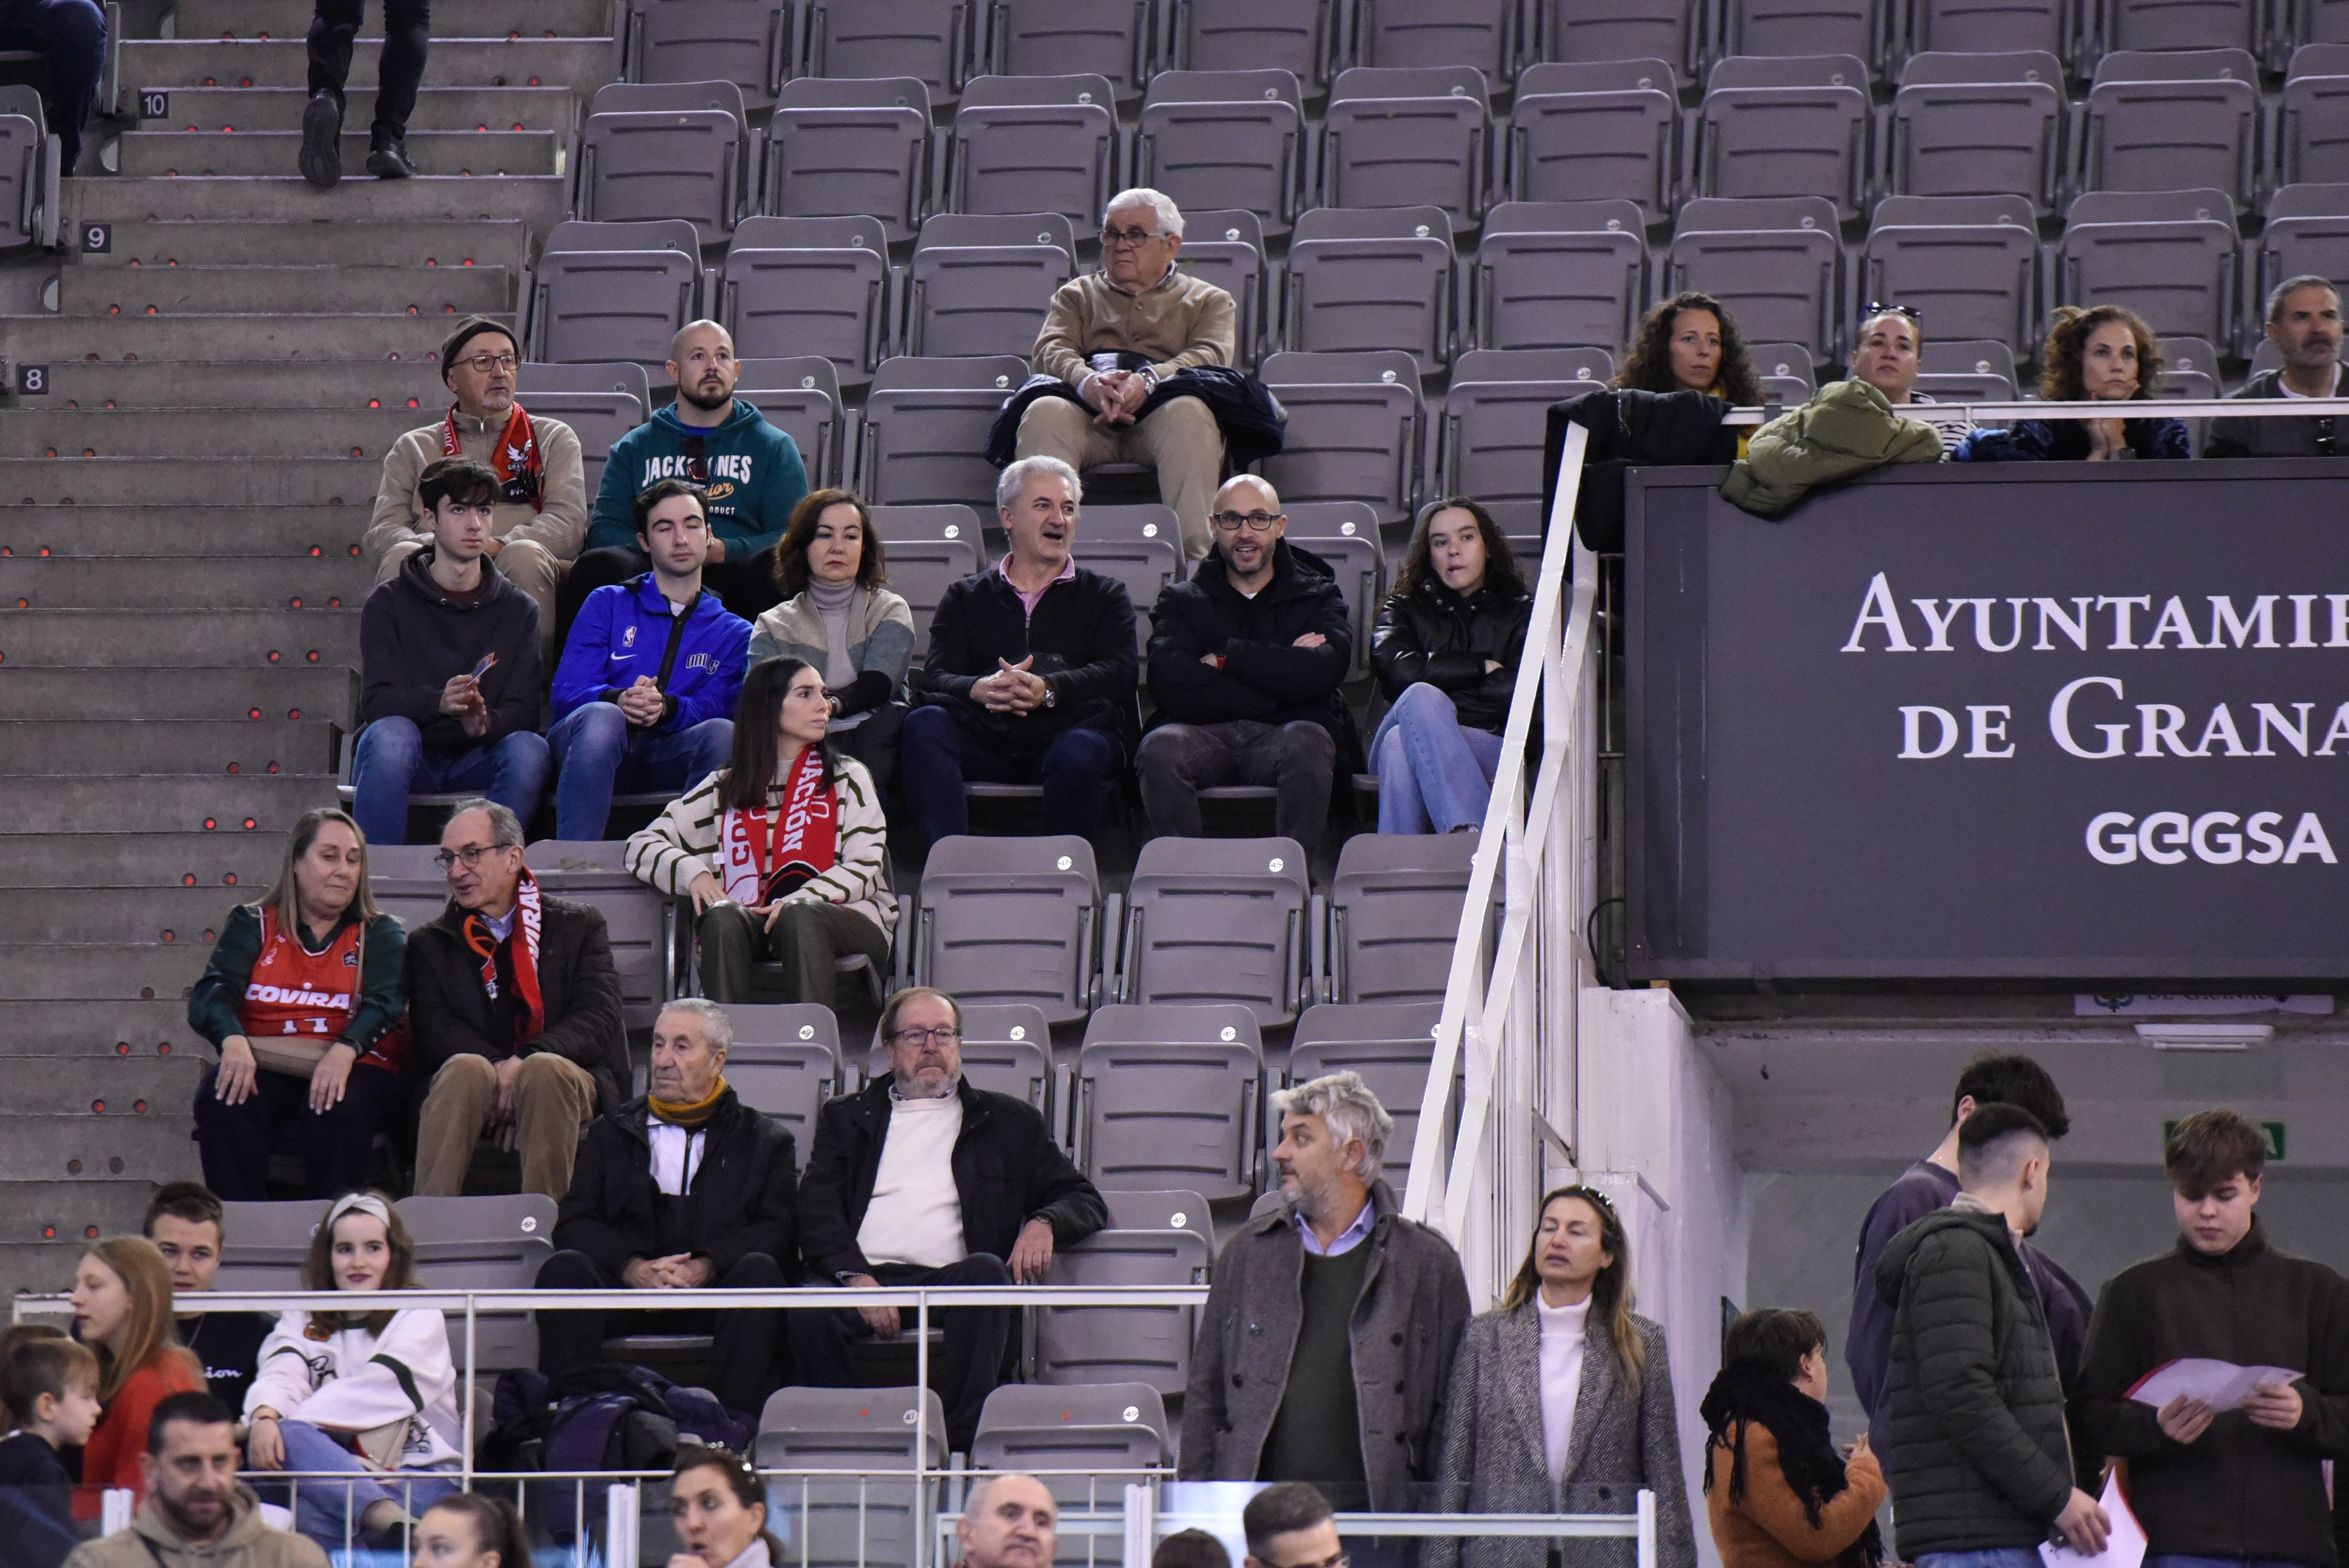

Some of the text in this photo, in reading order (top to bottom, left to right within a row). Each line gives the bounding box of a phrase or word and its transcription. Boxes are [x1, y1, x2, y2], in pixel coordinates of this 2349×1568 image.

[144, 95, 164, 115] 10
[89, 228, 104, 248] 9
[26, 369, 42, 389] 8
[709, 506, 735, 515] ODUCT
[1897, 677, 2349, 759] DE GRANA
[204, 1366, 243, 1379] ion
